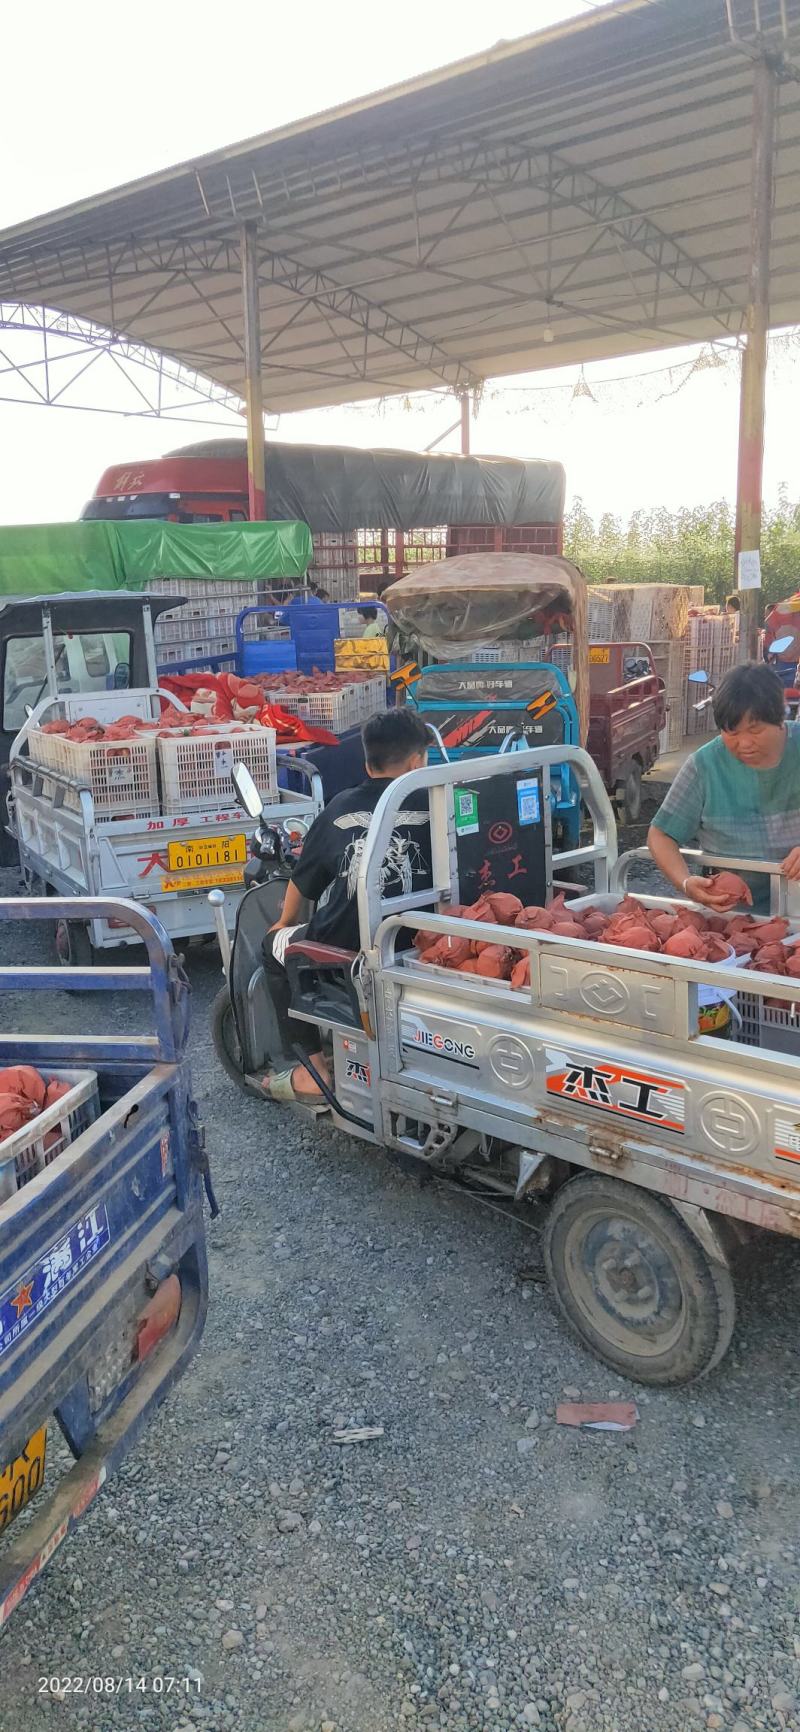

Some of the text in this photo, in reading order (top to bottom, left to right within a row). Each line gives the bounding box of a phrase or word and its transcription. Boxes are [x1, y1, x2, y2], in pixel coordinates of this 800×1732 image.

[176, 849, 238, 868] 0101181
[414, 1030, 476, 1059] JIEGONG
[560, 1062, 671, 1120] 杰工
